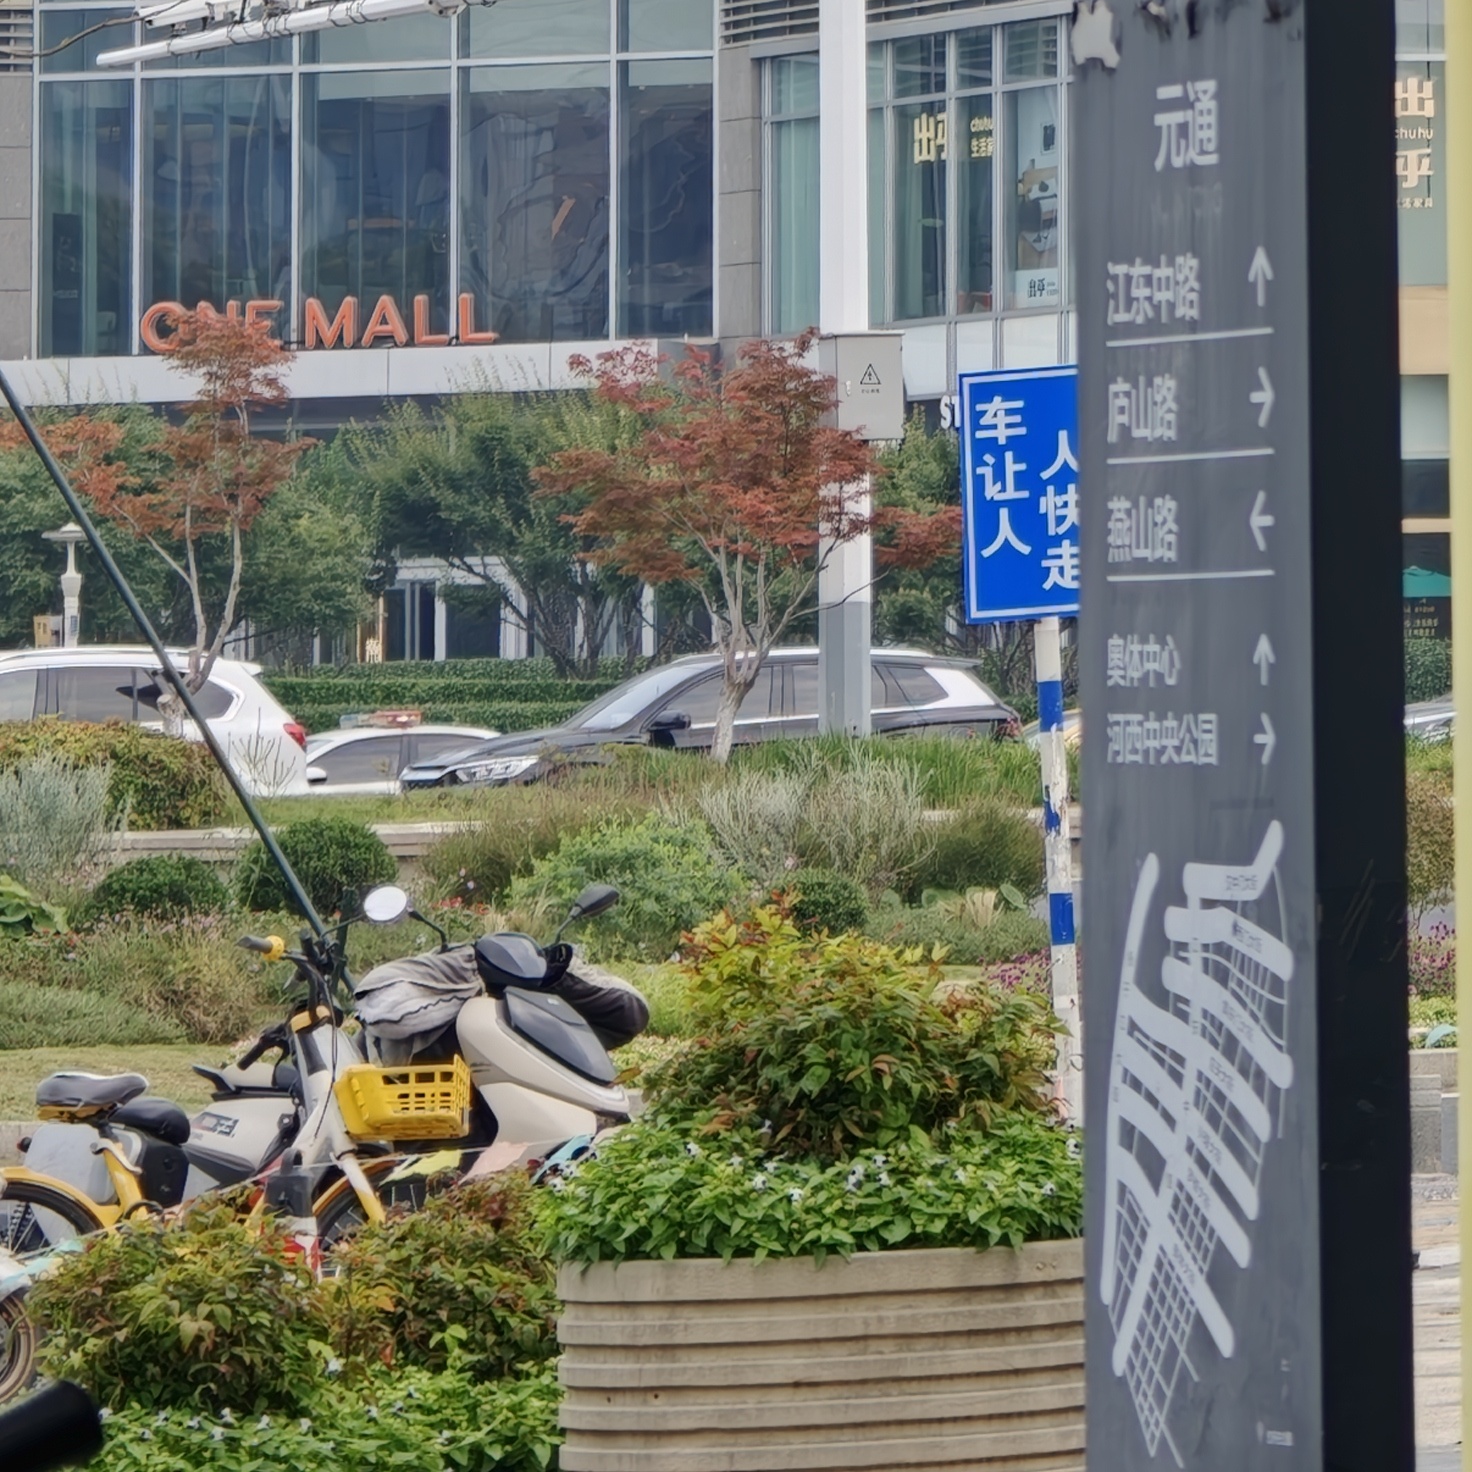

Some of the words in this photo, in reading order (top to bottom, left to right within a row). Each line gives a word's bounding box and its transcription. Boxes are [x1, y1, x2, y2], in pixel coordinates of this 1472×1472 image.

[1153, 78, 1220, 173] 元通
[305, 294, 499, 349] MALL
[1106, 253, 1201, 326] 江东中路
[1107, 373, 1179, 444] 庐山路
[975, 395, 1033, 558] 车让人
[1107, 494, 1180, 563] 燕山路
[1107, 634, 1182, 688] 奥体中心
[1107, 711, 1220, 766] 河西中央公园
